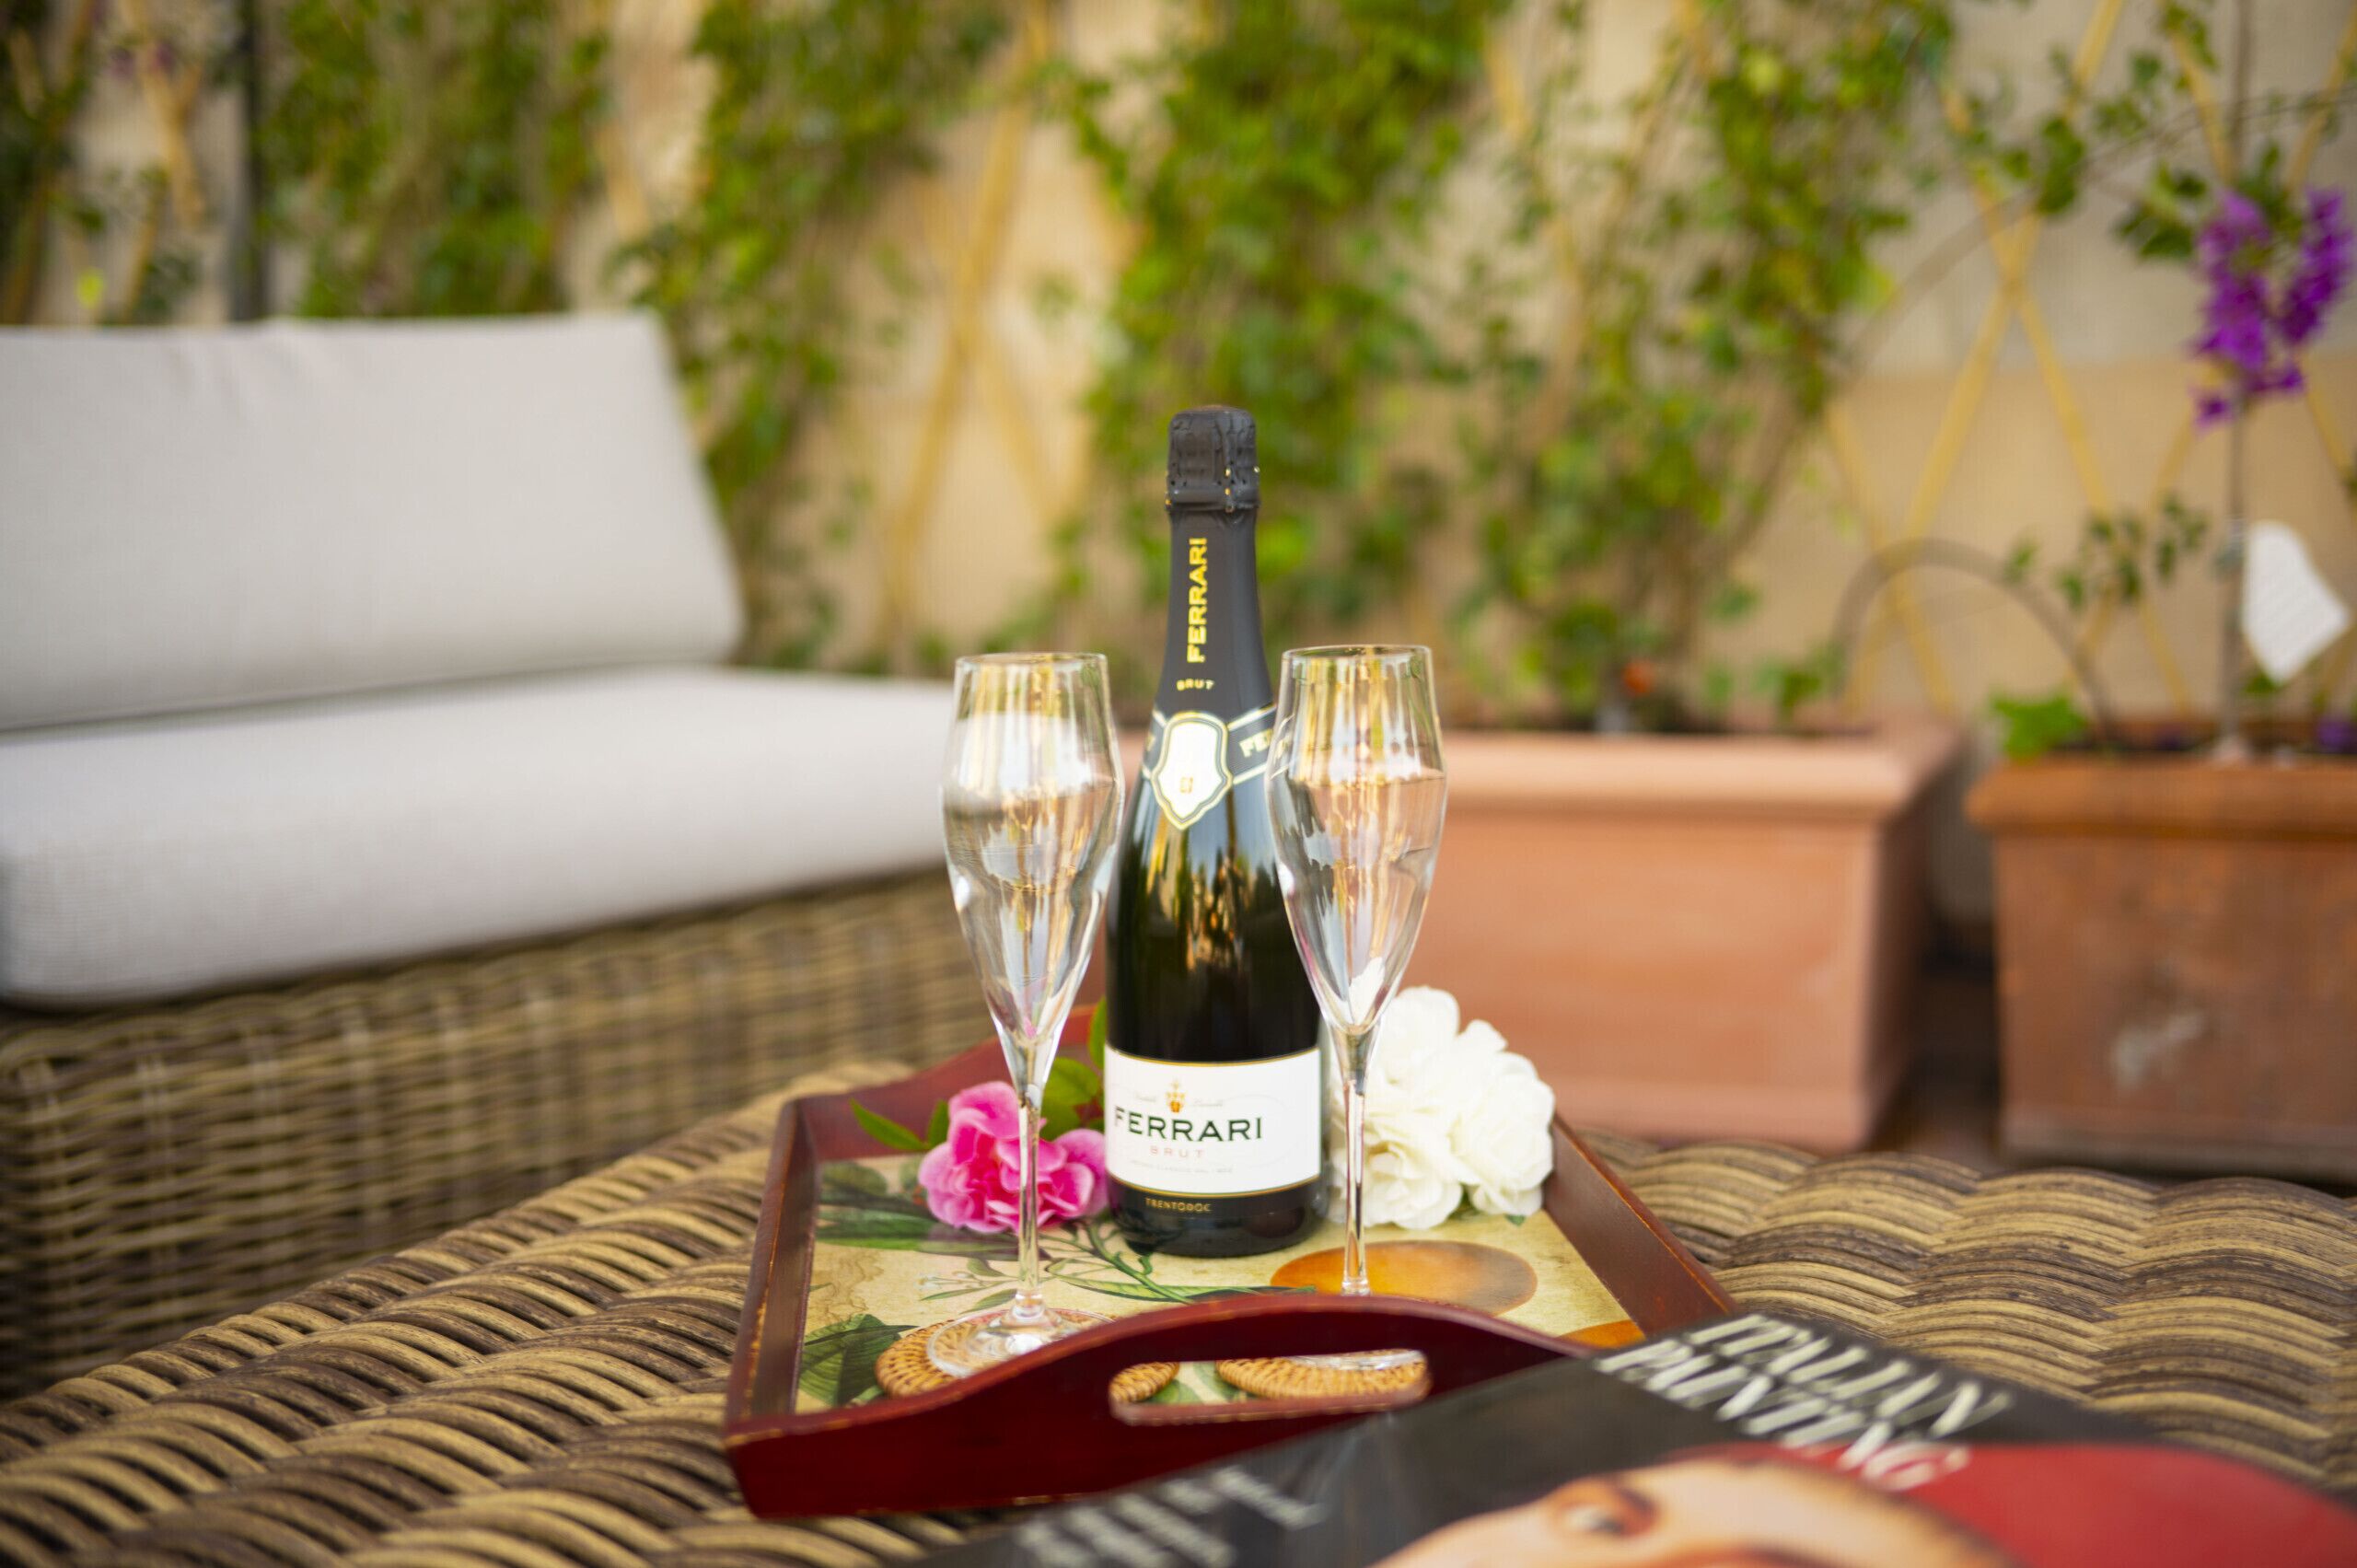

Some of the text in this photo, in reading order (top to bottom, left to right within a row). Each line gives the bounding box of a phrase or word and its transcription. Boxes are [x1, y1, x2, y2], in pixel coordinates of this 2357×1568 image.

[1187, 538, 1208, 663] FERRARI
[1177, 679, 1214, 691] BRUT
[1113, 1106, 1263, 1143] FERRARI
[1149, 1145, 1205, 1159] BRUT
[1145, 1197, 1212, 1213] TRENTODOC
[1687, 1313, 2013, 1439] ITALIAN
